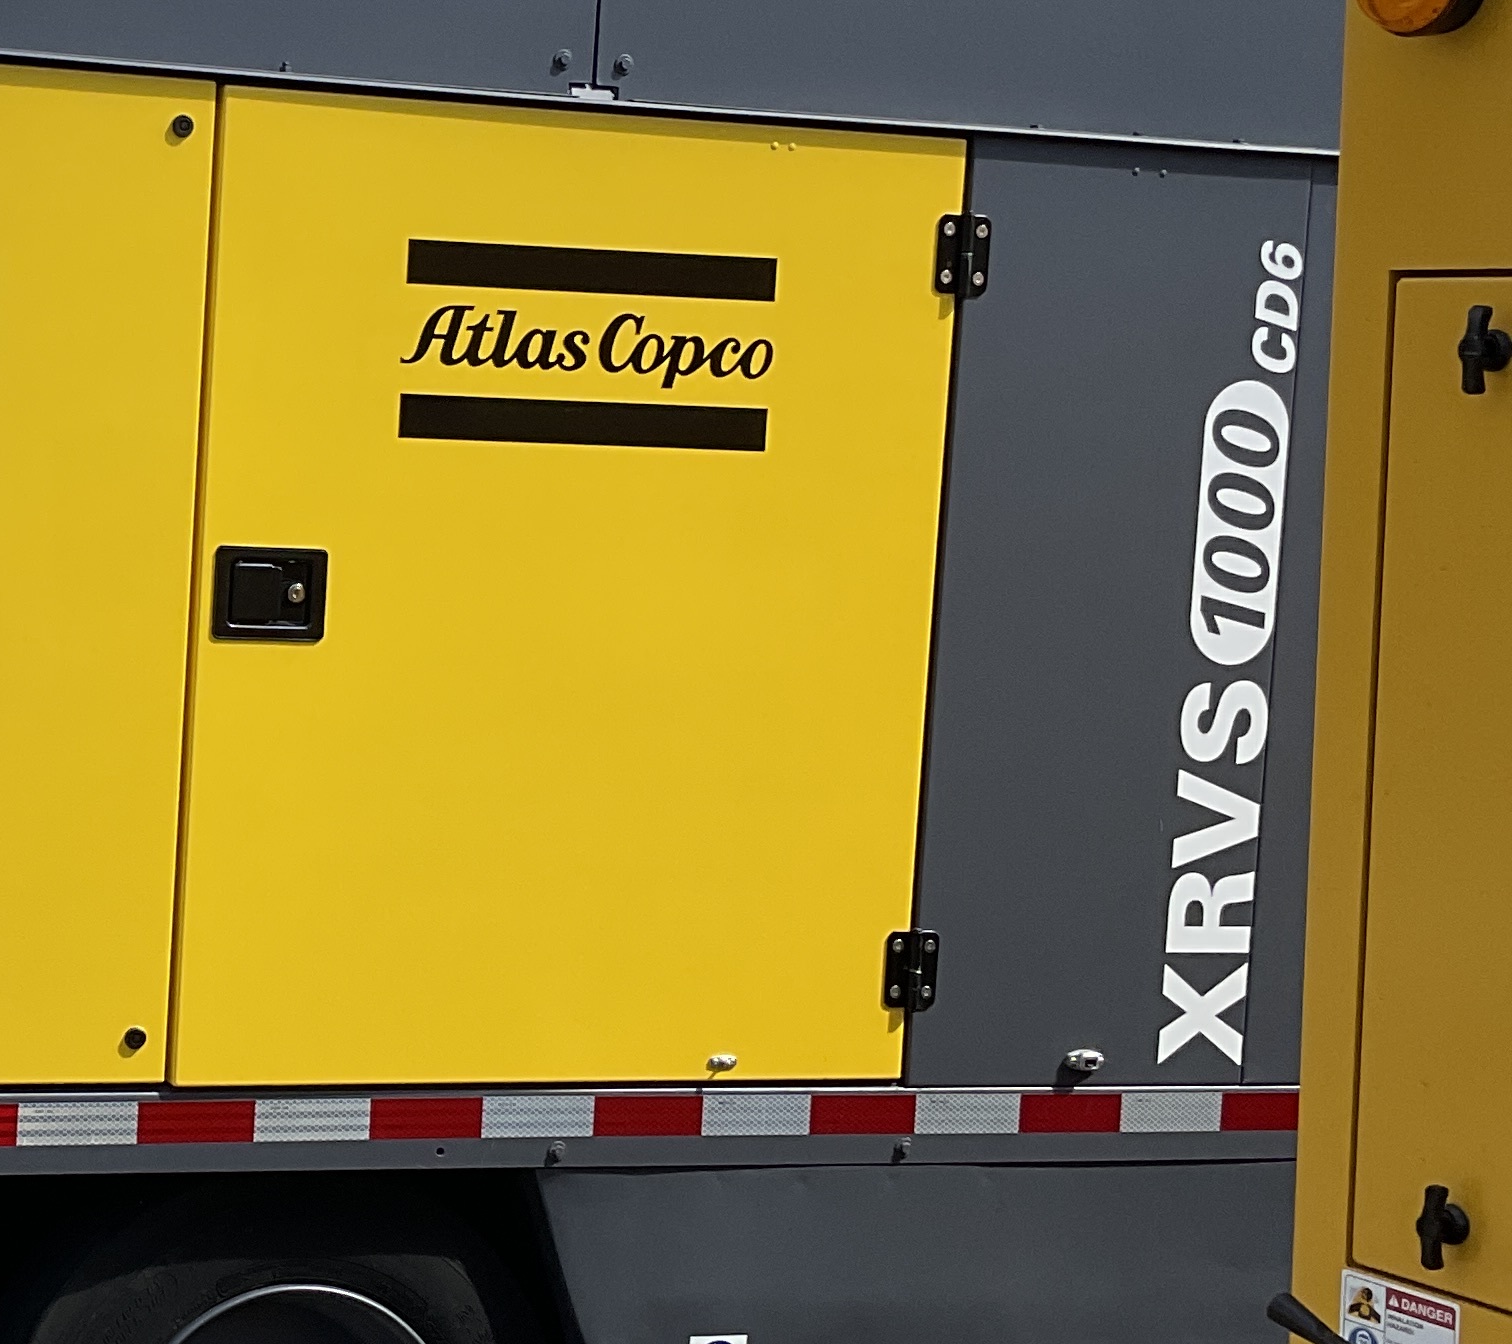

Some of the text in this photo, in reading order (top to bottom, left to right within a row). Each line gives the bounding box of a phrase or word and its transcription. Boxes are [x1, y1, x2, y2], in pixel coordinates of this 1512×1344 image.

[400, 304, 774, 389] Atlas Copco
[1157, 239, 1303, 1065] XRVS 1000 CD6
[1401, 1298, 1453, 1325] DANGER
